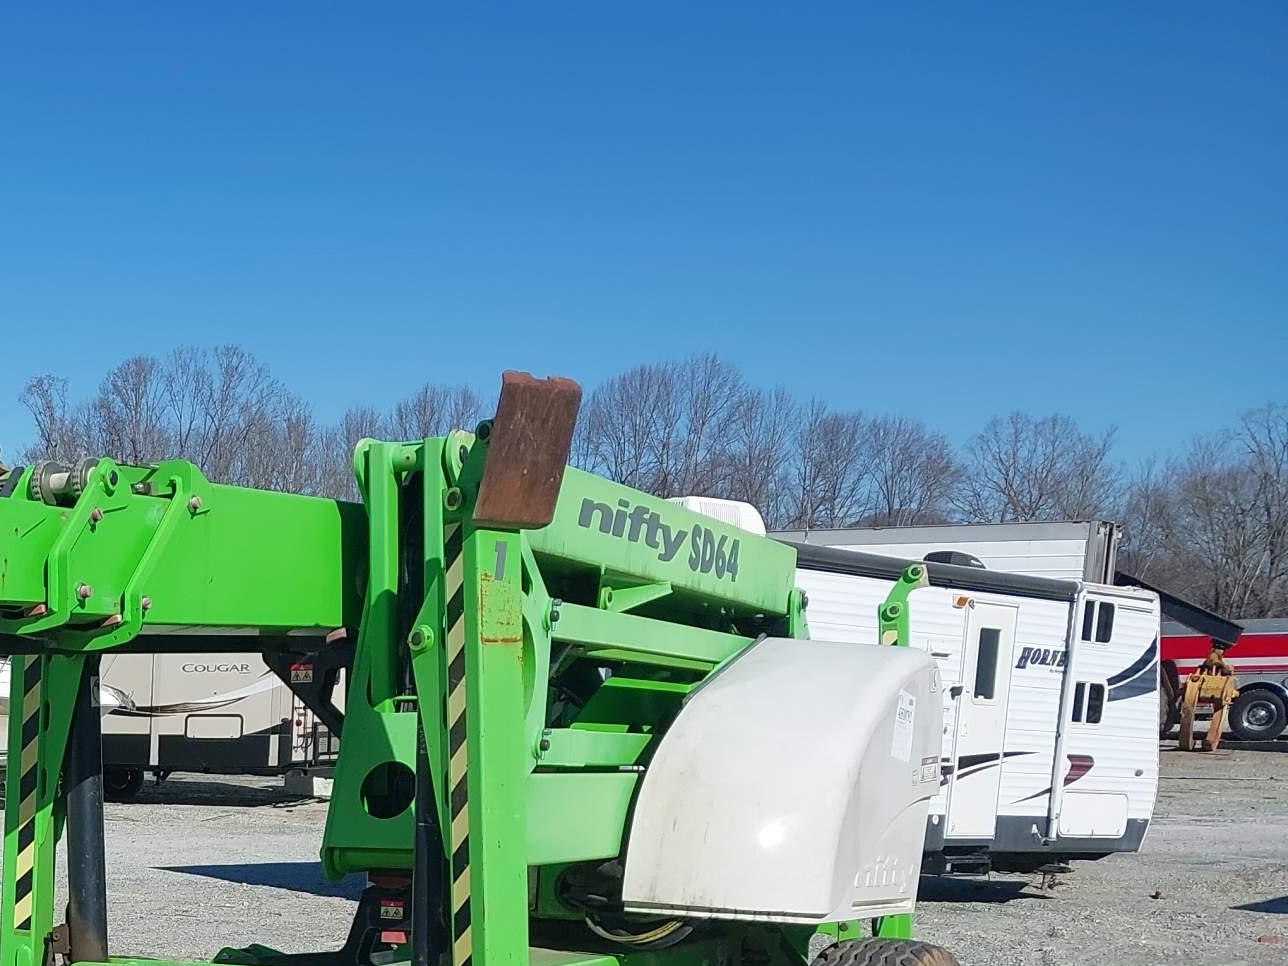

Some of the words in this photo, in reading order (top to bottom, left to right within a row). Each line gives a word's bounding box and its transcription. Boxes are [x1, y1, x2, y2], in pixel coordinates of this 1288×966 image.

[494, 541, 508, 581] 1
[578, 497, 688, 562] nifty
[688, 523, 741, 583] SD64
